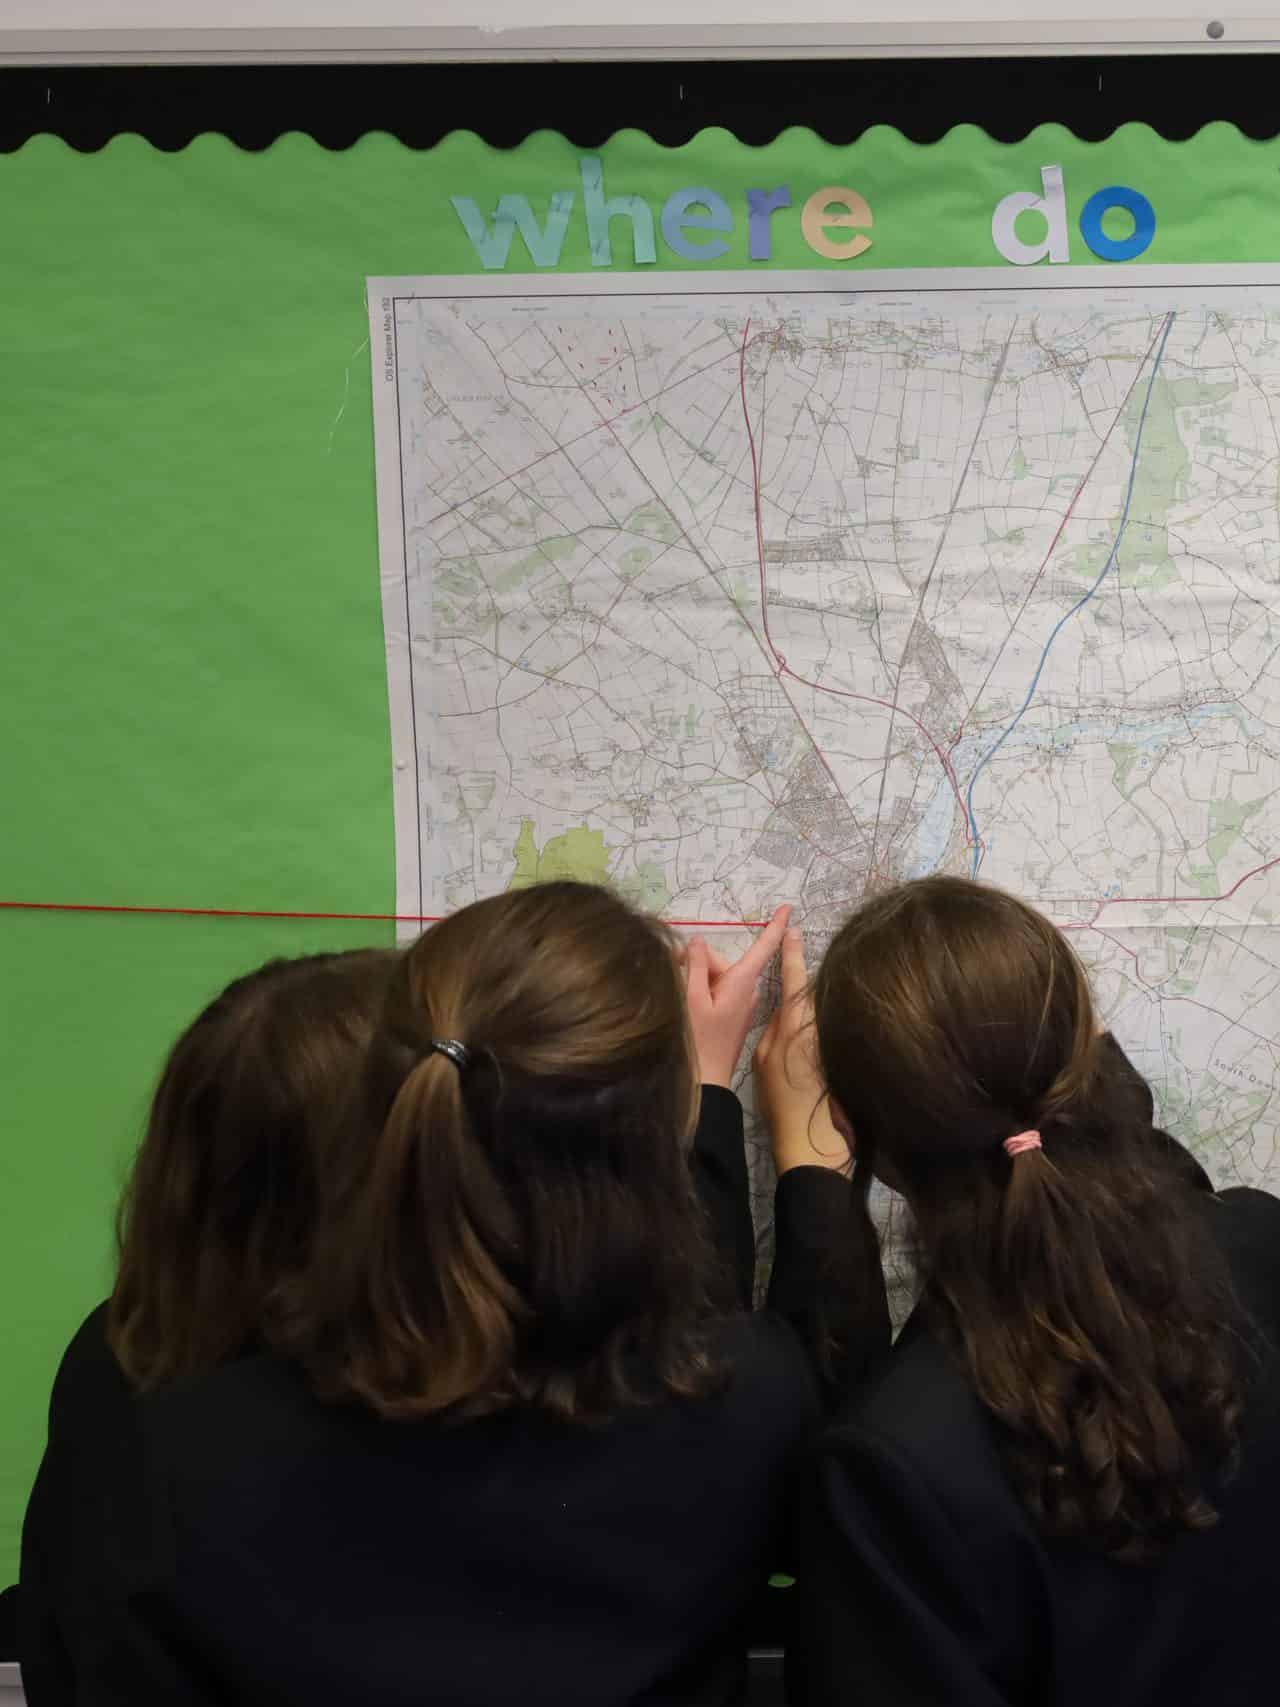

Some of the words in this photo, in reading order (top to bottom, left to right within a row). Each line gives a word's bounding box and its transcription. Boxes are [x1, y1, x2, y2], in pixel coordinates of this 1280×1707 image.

[449, 155, 875, 269] where
[991, 165, 1157, 266] do
[383, 312, 393, 332] Map
